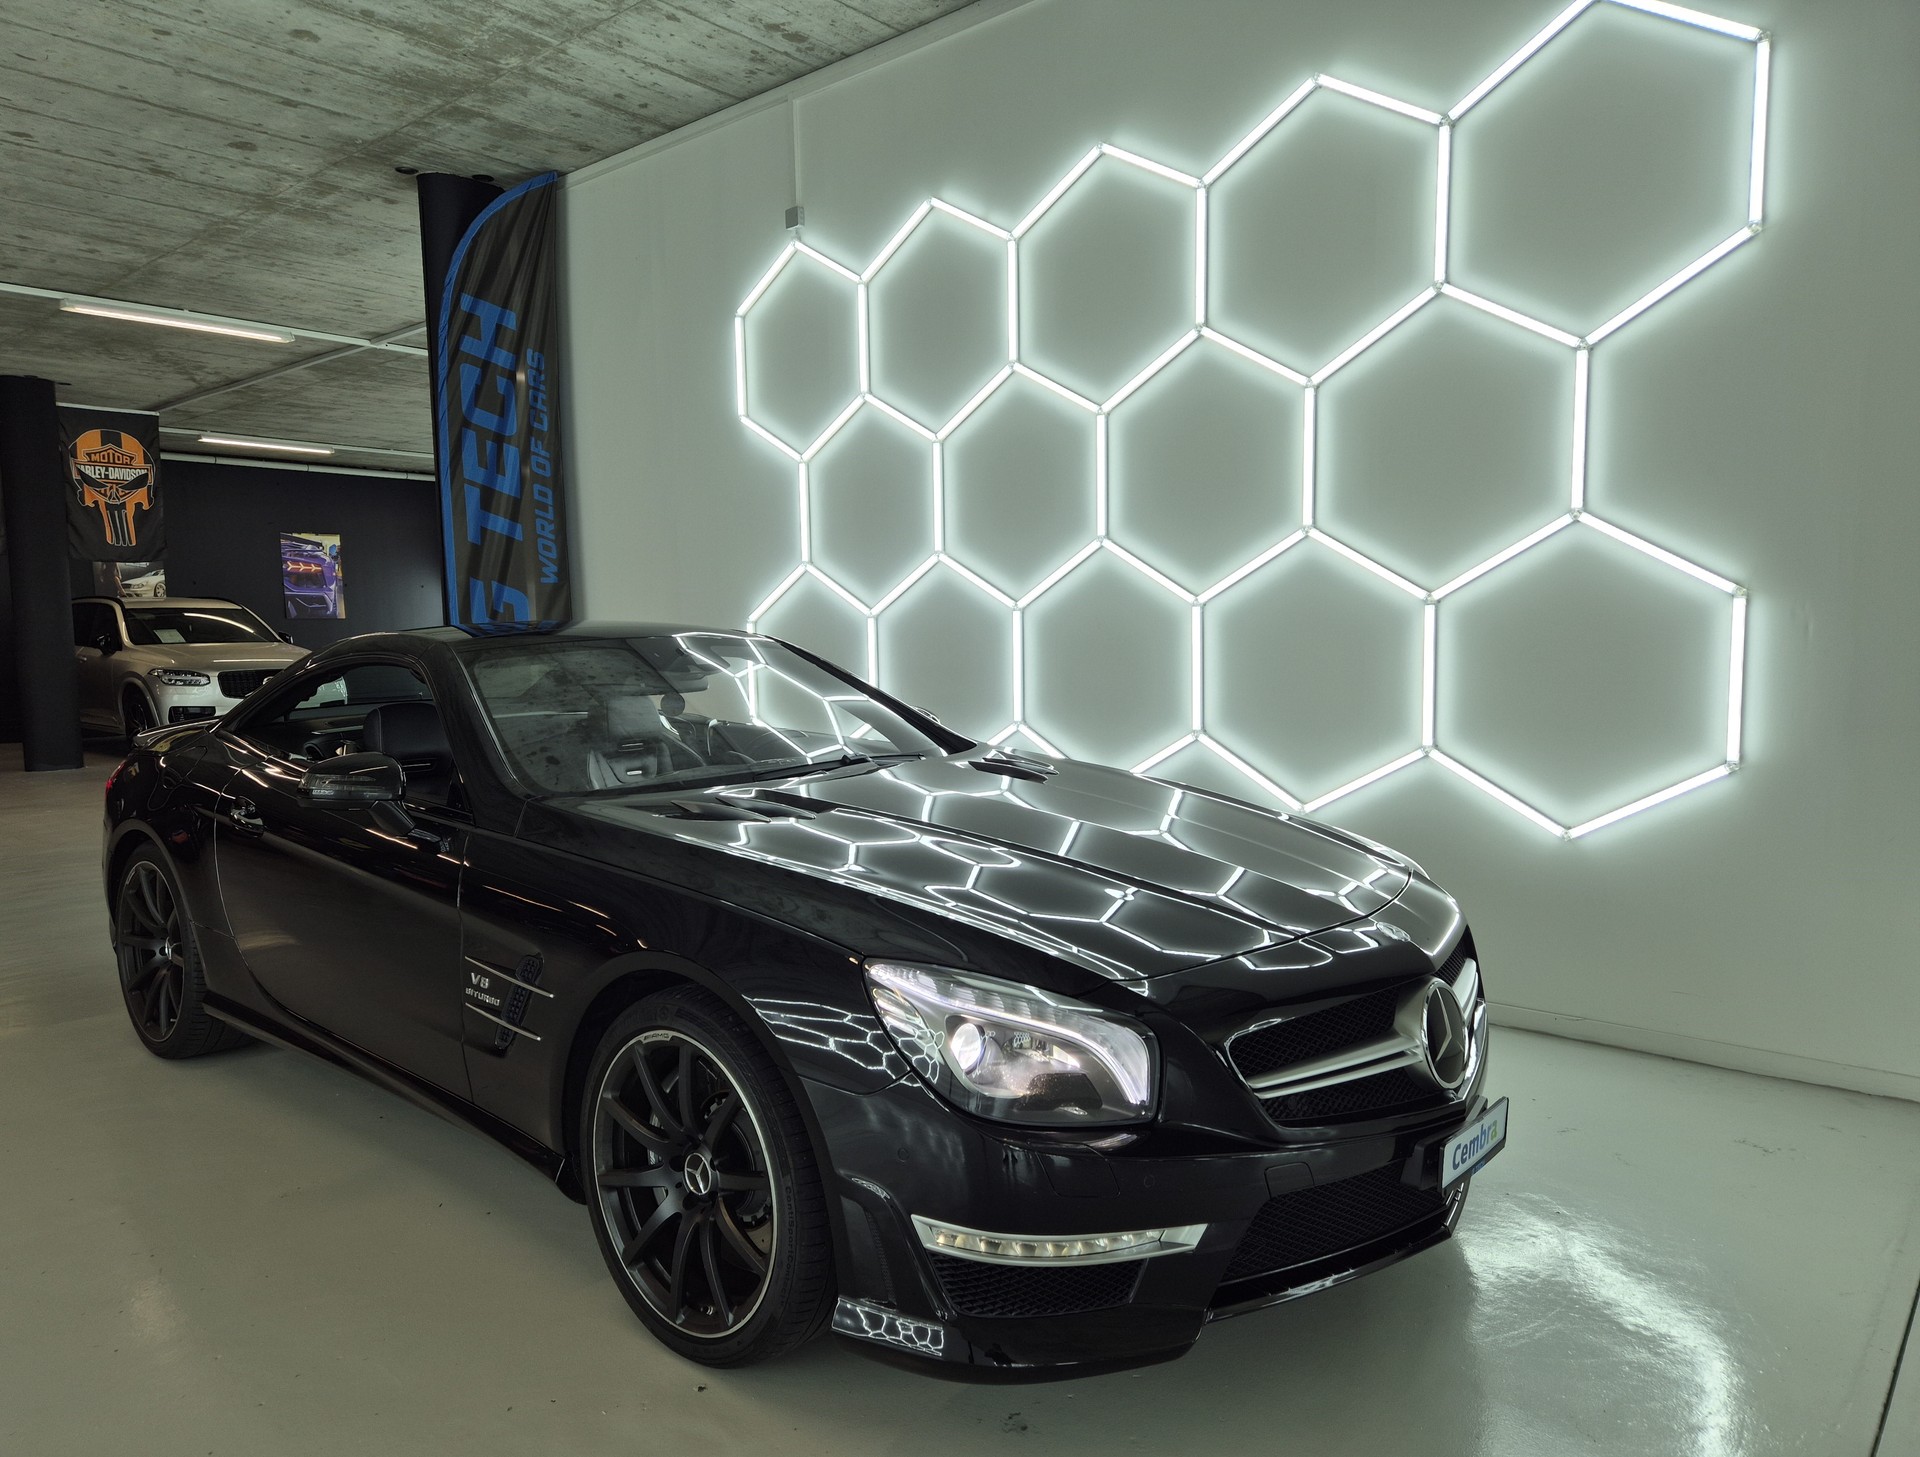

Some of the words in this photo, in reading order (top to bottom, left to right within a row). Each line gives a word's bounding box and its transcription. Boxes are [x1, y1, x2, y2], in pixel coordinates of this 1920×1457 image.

[526, 348, 548, 432] CARS
[459, 292, 524, 546] TECH
[91, 450, 131, 464] MOTOR
[530, 437, 551, 478] OF
[532, 484, 559, 584] WORLD
[465, 987, 500, 1006] BITURBO
[471, 973, 489, 988] V8
[1453, 1120, 1497, 1170] Cembra
